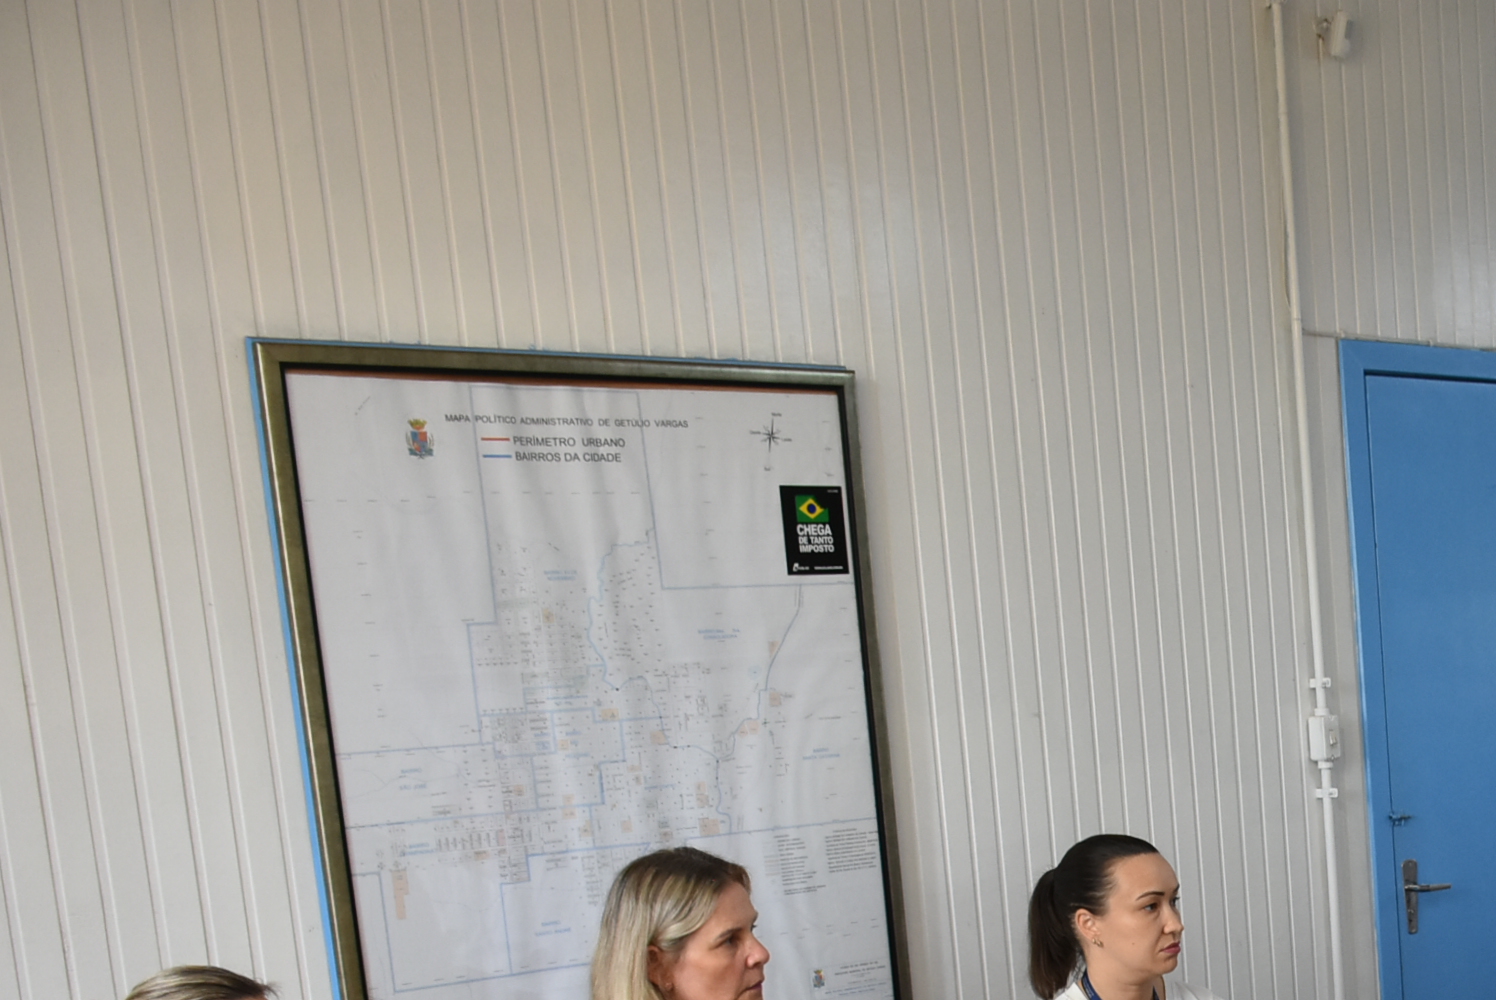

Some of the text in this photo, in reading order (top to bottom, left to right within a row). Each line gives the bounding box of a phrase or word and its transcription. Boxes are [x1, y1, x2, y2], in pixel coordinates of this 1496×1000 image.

[444, 413, 689, 428] MAPA POLÍTICO ADMINISTRATIVO DE GETÚLIO VARGAS
[513, 435, 625, 448] PERÍMETRO URBANO
[515, 452, 622, 463] BAIRROS DA CIDADE
[796, 523, 832, 536] CHEGA
[798, 536, 834, 545] DE TANTO
[799, 544, 835, 553] IMPOSTO
